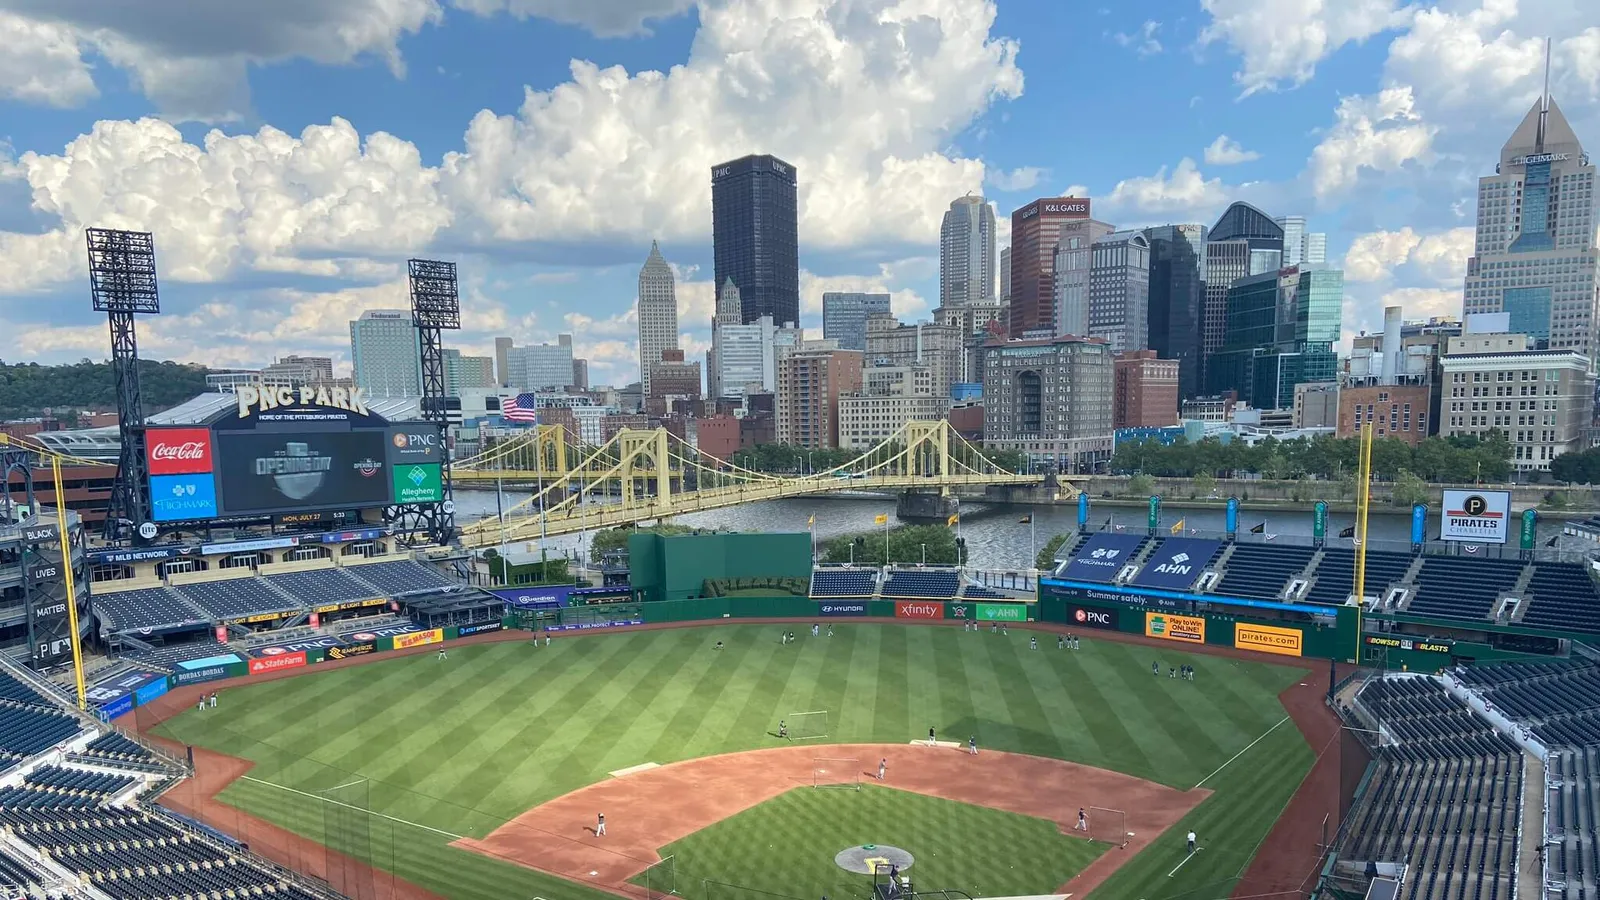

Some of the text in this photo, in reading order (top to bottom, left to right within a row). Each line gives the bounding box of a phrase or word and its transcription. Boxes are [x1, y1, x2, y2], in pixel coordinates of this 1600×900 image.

[1514, 153, 1569, 165] HIGHMARK
[236, 385, 370, 418] PNC PARK
[408, 434, 436, 446] PNC
[152, 442, 206, 460] Coca-Cola
[402, 488, 435, 496] Allegheny
[156, 499, 213, 510] HIGHMARK
[1470, 500, 1480, 512] P
[1450, 518, 1497, 528] PIRATES
[26, 528, 54, 540] BLACK
[142, 525, 156, 534] Lite
[133, 550, 169, 560] NETWORK
[35, 567, 56, 579] LIVES
[1154, 563, 1192, 575] AHN
[704, 576, 809, 597] PIRATES
[1087, 590, 1147, 605] Summer safely.
[37, 603, 66, 618] MATTER
[901, 604, 938, 616] xfinity
[997, 608, 1018, 617] AHN
[1087, 611, 1110, 624] PNC
[374, 625, 422, 637] PNC
[476, 623, 501, 632] SPORTSNET
[288, 639, 338, 651] PNC
[1242, 633, 1295, 645] pirates.com
[1370, 638, 1400, 647] BOWSER
[40, 644, 48, 658] P
[1420, 643, 1449, 652] BLASTS
[179, 670, 200, 680] BORDAS
[203, 667, 224, 677] BORDAS
